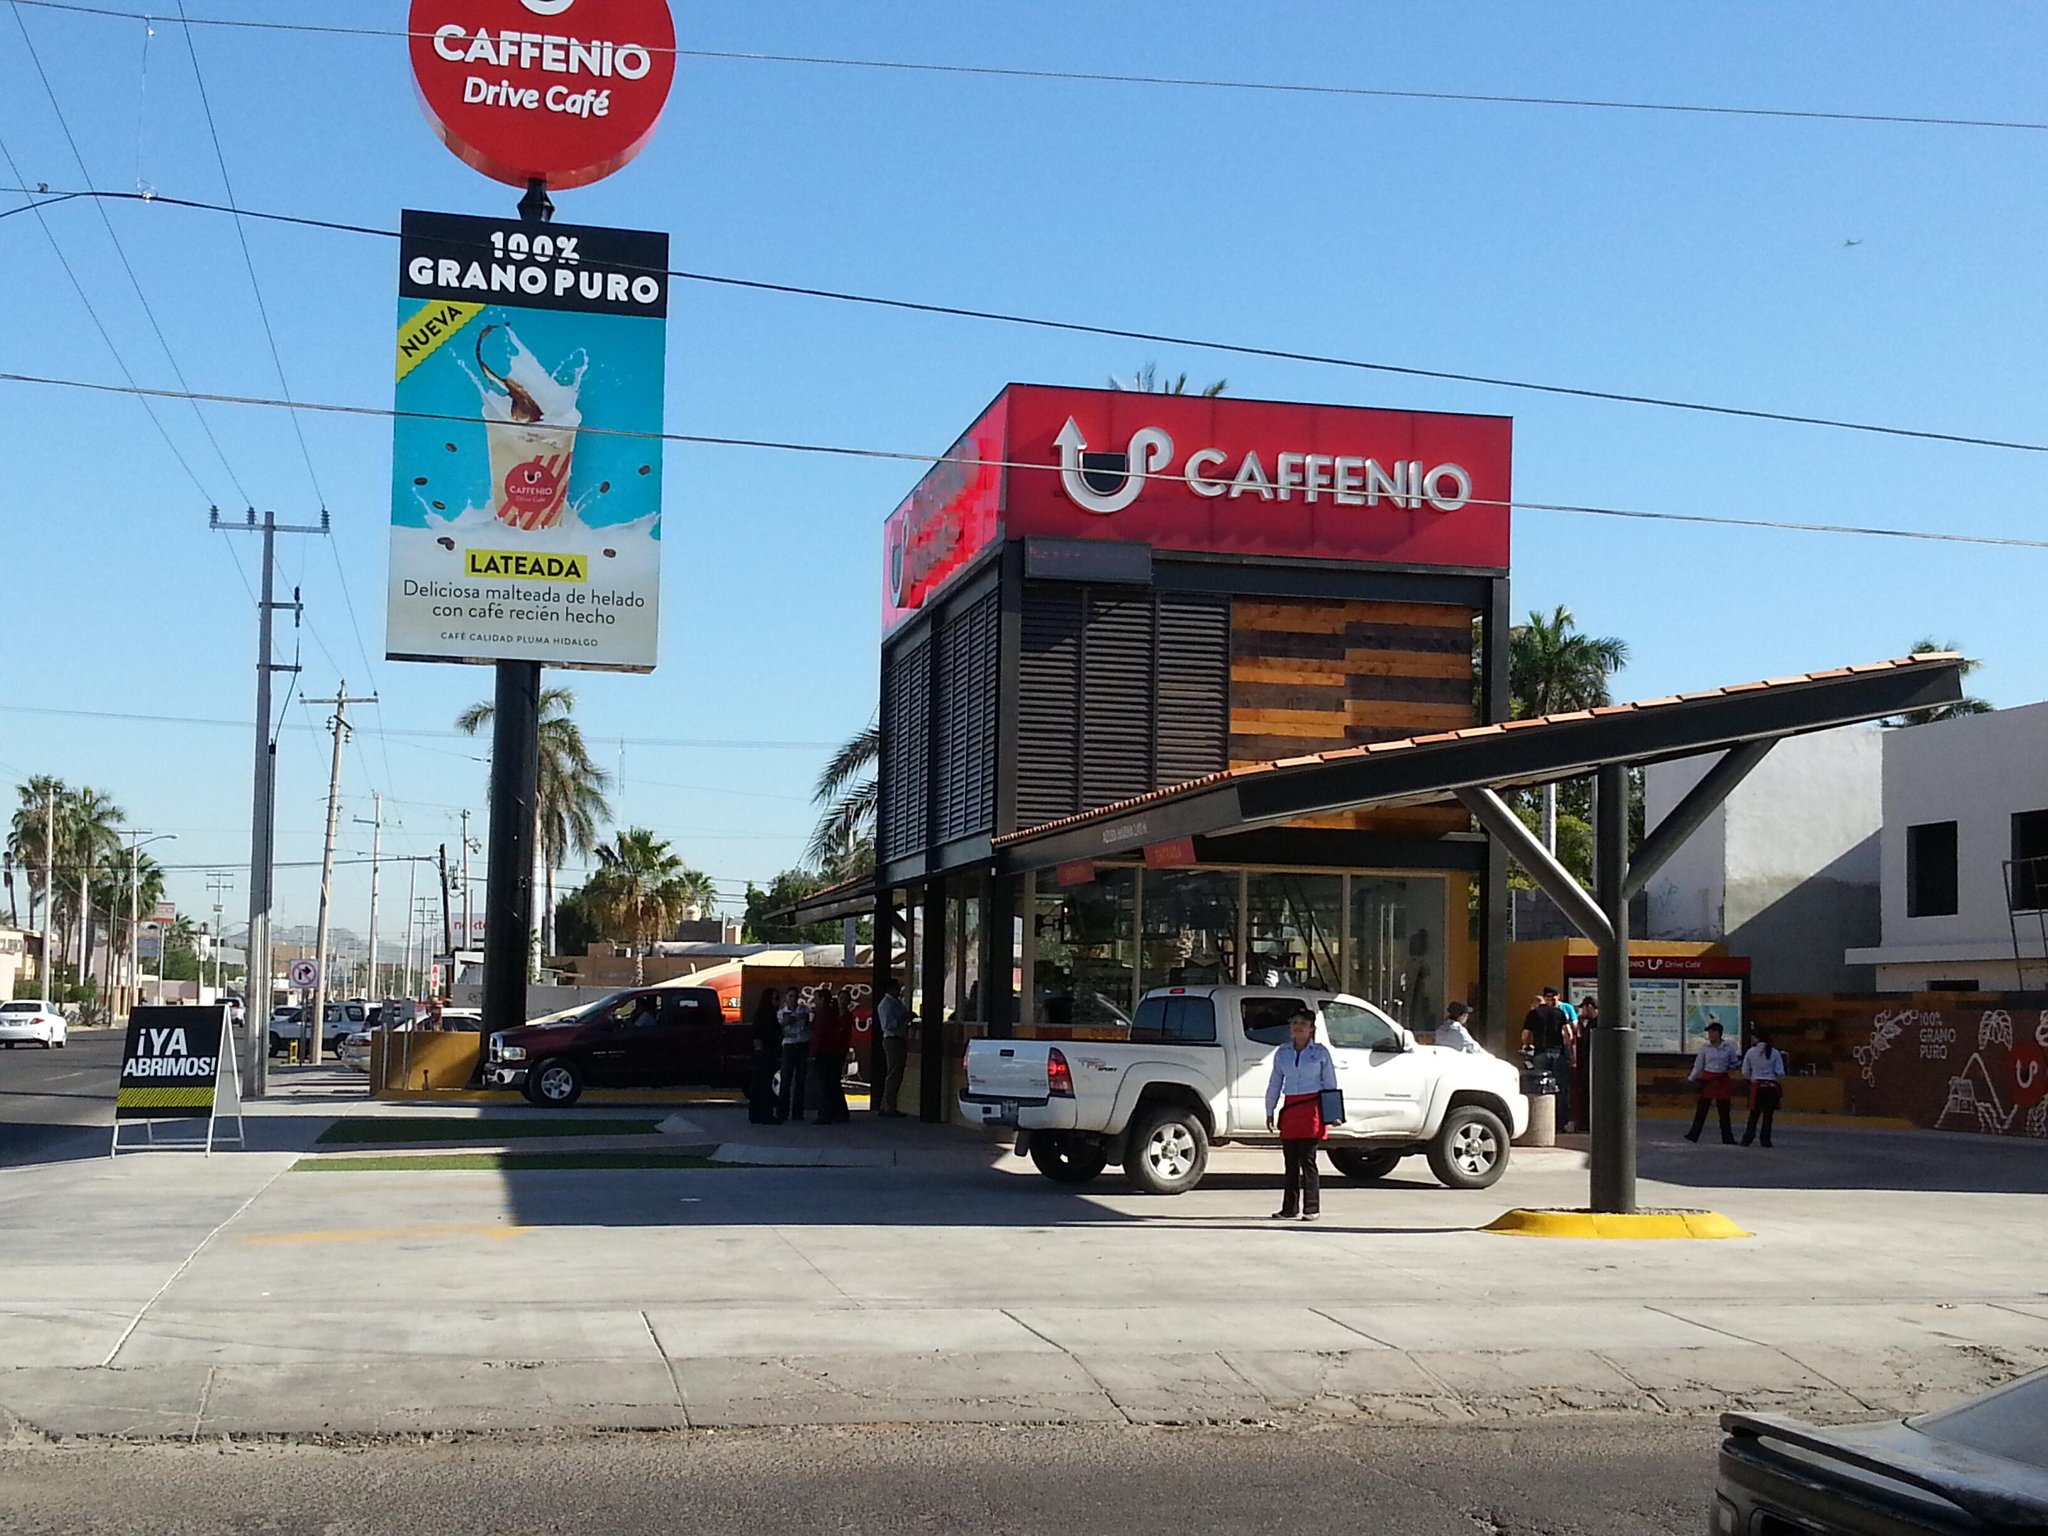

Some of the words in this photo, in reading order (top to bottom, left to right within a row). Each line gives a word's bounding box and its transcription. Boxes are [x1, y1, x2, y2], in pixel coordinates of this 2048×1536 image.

[433, 23, 651, 80] CAFFENIO
[463, 76, 539, 110] Drive
[545, 85, 612, 119] Café
[490, 231, 580, 265] 100%
[408, 257, 548, 294] GRANO
[554, 269, 660, 304] PURO
[400, 306, 462, 358] NUEVA
[1184, 447, 1474, 513] CAFFENIO
[470, 554, 582, 578] LATEADA
[403, 579, 480, 599] Deliciosa
[485, 584, 560, 603] malteada
[566, 588, 586, 605] de
[591, 590, 645, 608] helado
[432, 603, 463, 618] con
[468, 603, 504, 620] café
[509, 605, 560, 622] recién
[565, 607, 616, 625] hecho
[440, 631, 466, 641] CAFÉ
[470, 633, 514, 643] CALIDAD
[516, 635, 550, 645] PLUMA
[553, 637, 599, 647] HIDALGO
[1919, 1011, 1943, 1027] 100%
[137, 1028, 188, 1056] ¡YA
[1919, 1028, 1957, 1043] GRANO
[1919, 1044, 1949, 1060] PURO
[122, 1057, 217, 1077] ABRIMOS!
